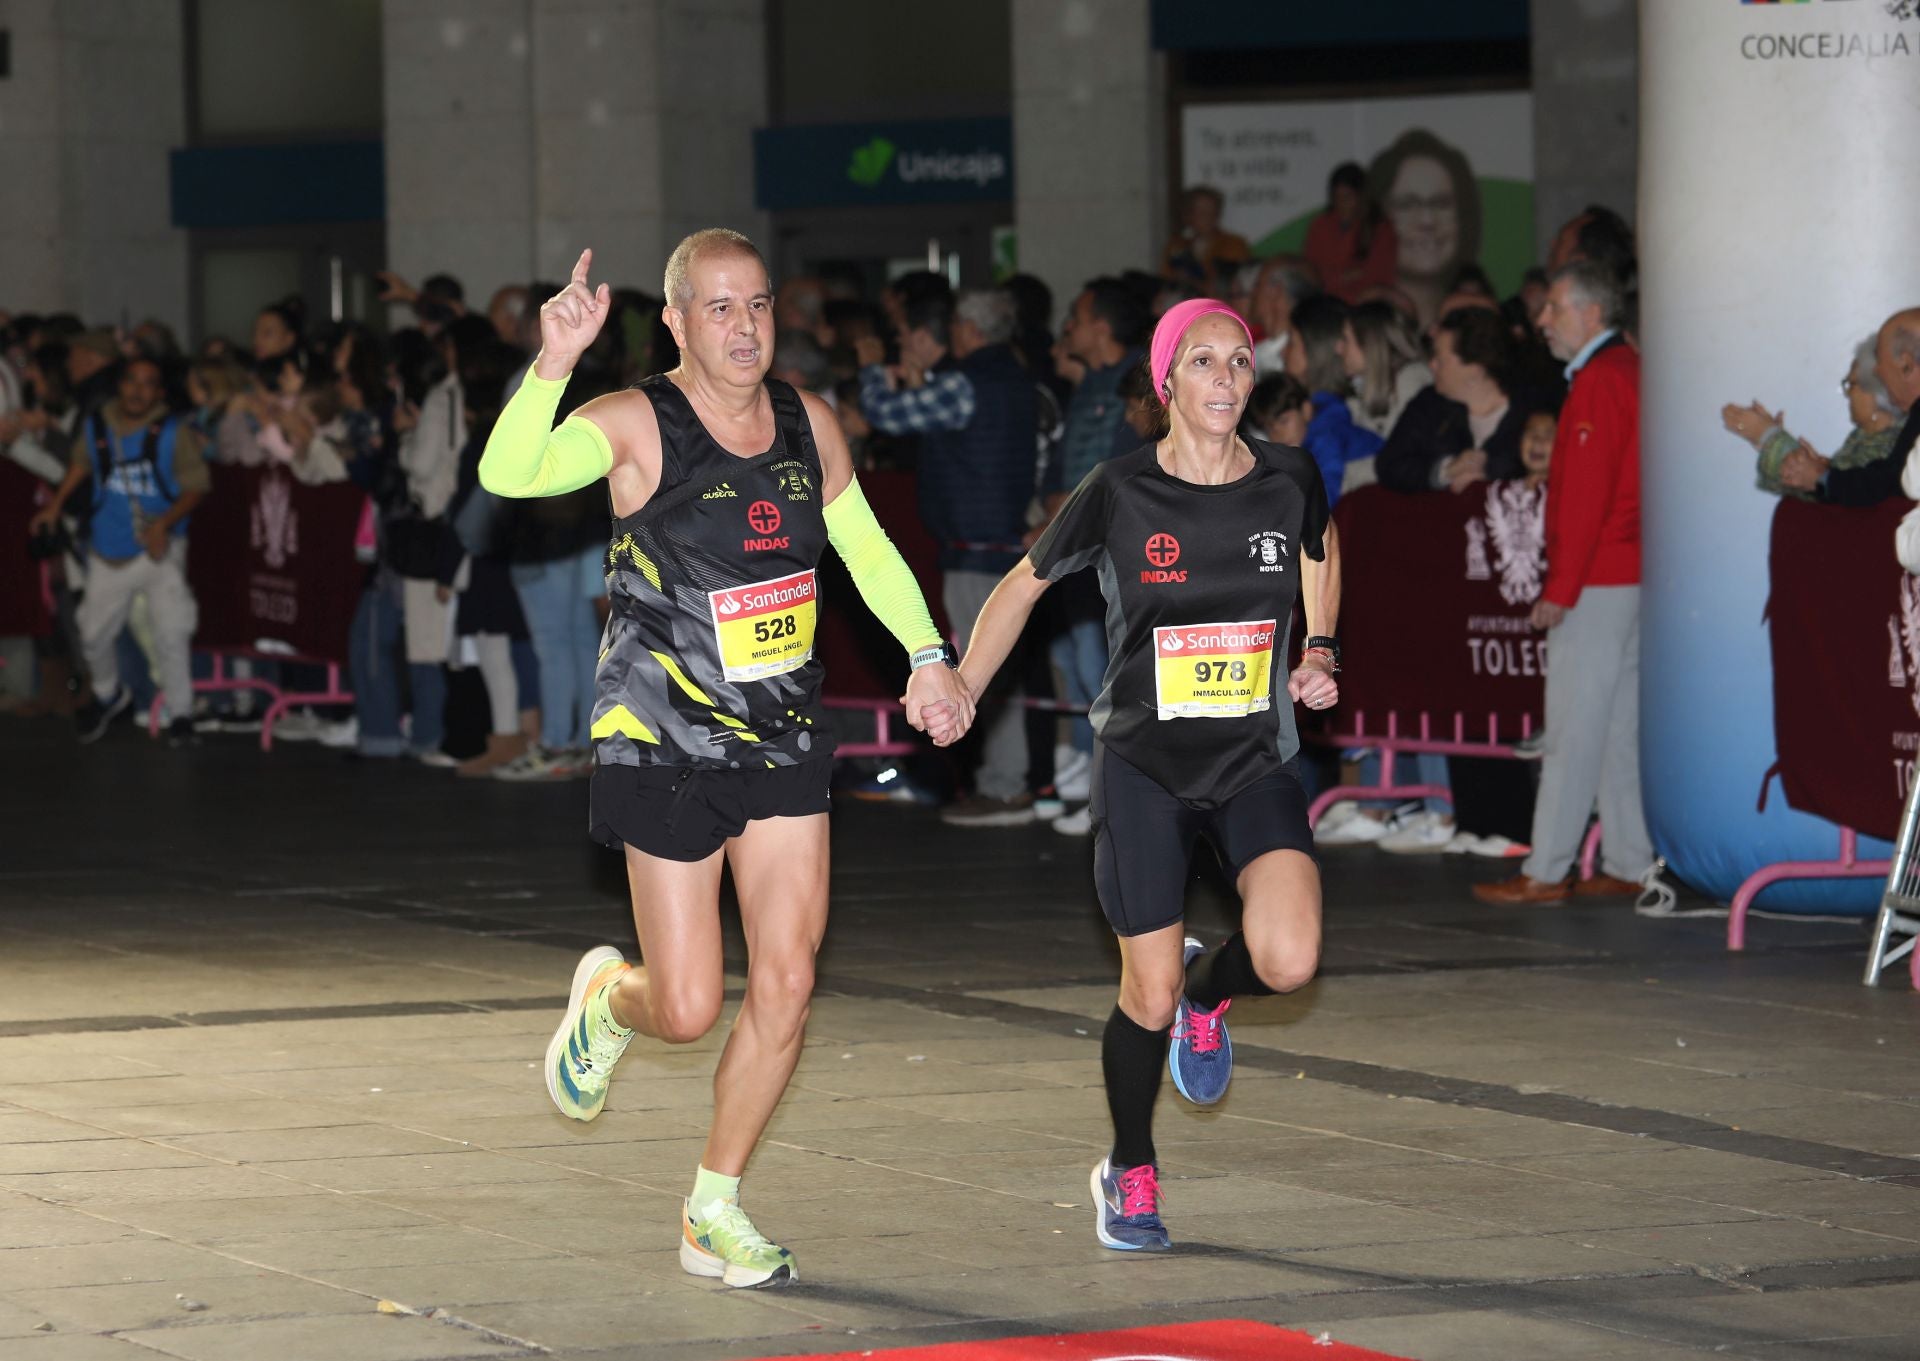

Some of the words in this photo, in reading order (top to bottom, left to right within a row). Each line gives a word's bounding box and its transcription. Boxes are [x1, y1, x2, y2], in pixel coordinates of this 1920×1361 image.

[1740, 33, 1911, 60] CONCEJALIA
[897, 149, 1003, 187] Unicaja
[743, 536, 790, 552] INDAS
[1248, 533, 1261, 542] CLUB
[1140, 570, 1188, 584] INDAS
[1259, 564, 1284, 573] NOVÉS
[742, 581, 812, 611] Santander
[754, 614, 797, 643] 528
[751, 647, 782, 659] MIGUEL
[783, 640, 803, 652] ANGEL
[1187, 631, 1271, 650] Santander
[1467, 638, 1548, 676] TOLED
[1194, 660, 1247, 682] 978
[1192, 688, 1251, 697] INMACULADA
